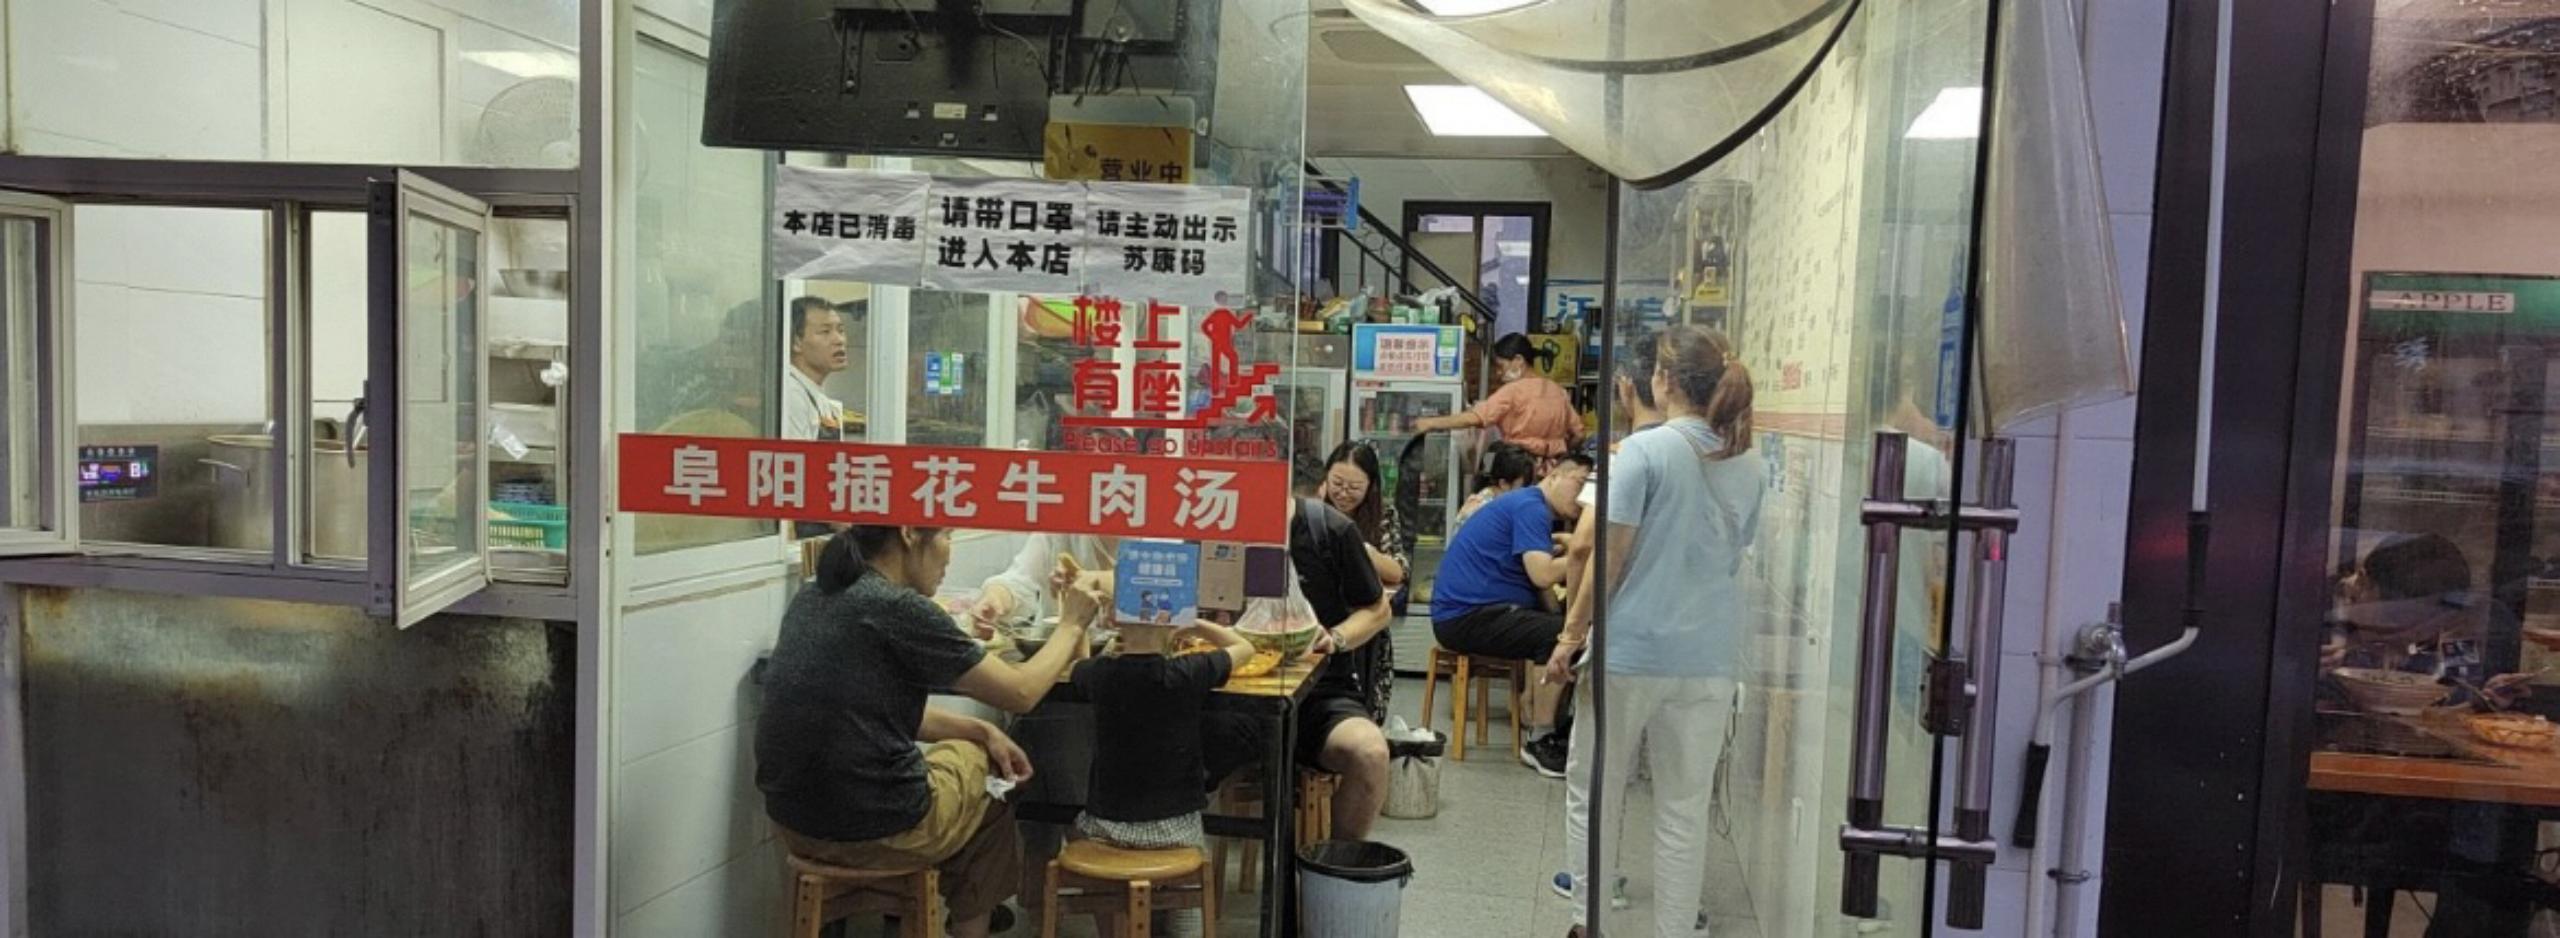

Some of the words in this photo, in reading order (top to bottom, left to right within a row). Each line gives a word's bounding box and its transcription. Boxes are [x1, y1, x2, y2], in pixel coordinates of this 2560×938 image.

[1101, 158, 1182, 183] 营业中
[783, 209, 916, 241] 本店已消毒
[941, 195, 1073, 234] 请带口罩
[1096, 210, 1237, 242] 请主动出示
[938, 236, 1071, 276] 进入本店
[1123, 246, 1206, 276] 苏康码
[2393, 292, 2507, 312] APPLE
[1072, 296, 1181, 348] 楼上
[1072, 358, 1181, 412] 有座
[664, 445, 1240, 531] 阜阳插花牛肉汤
